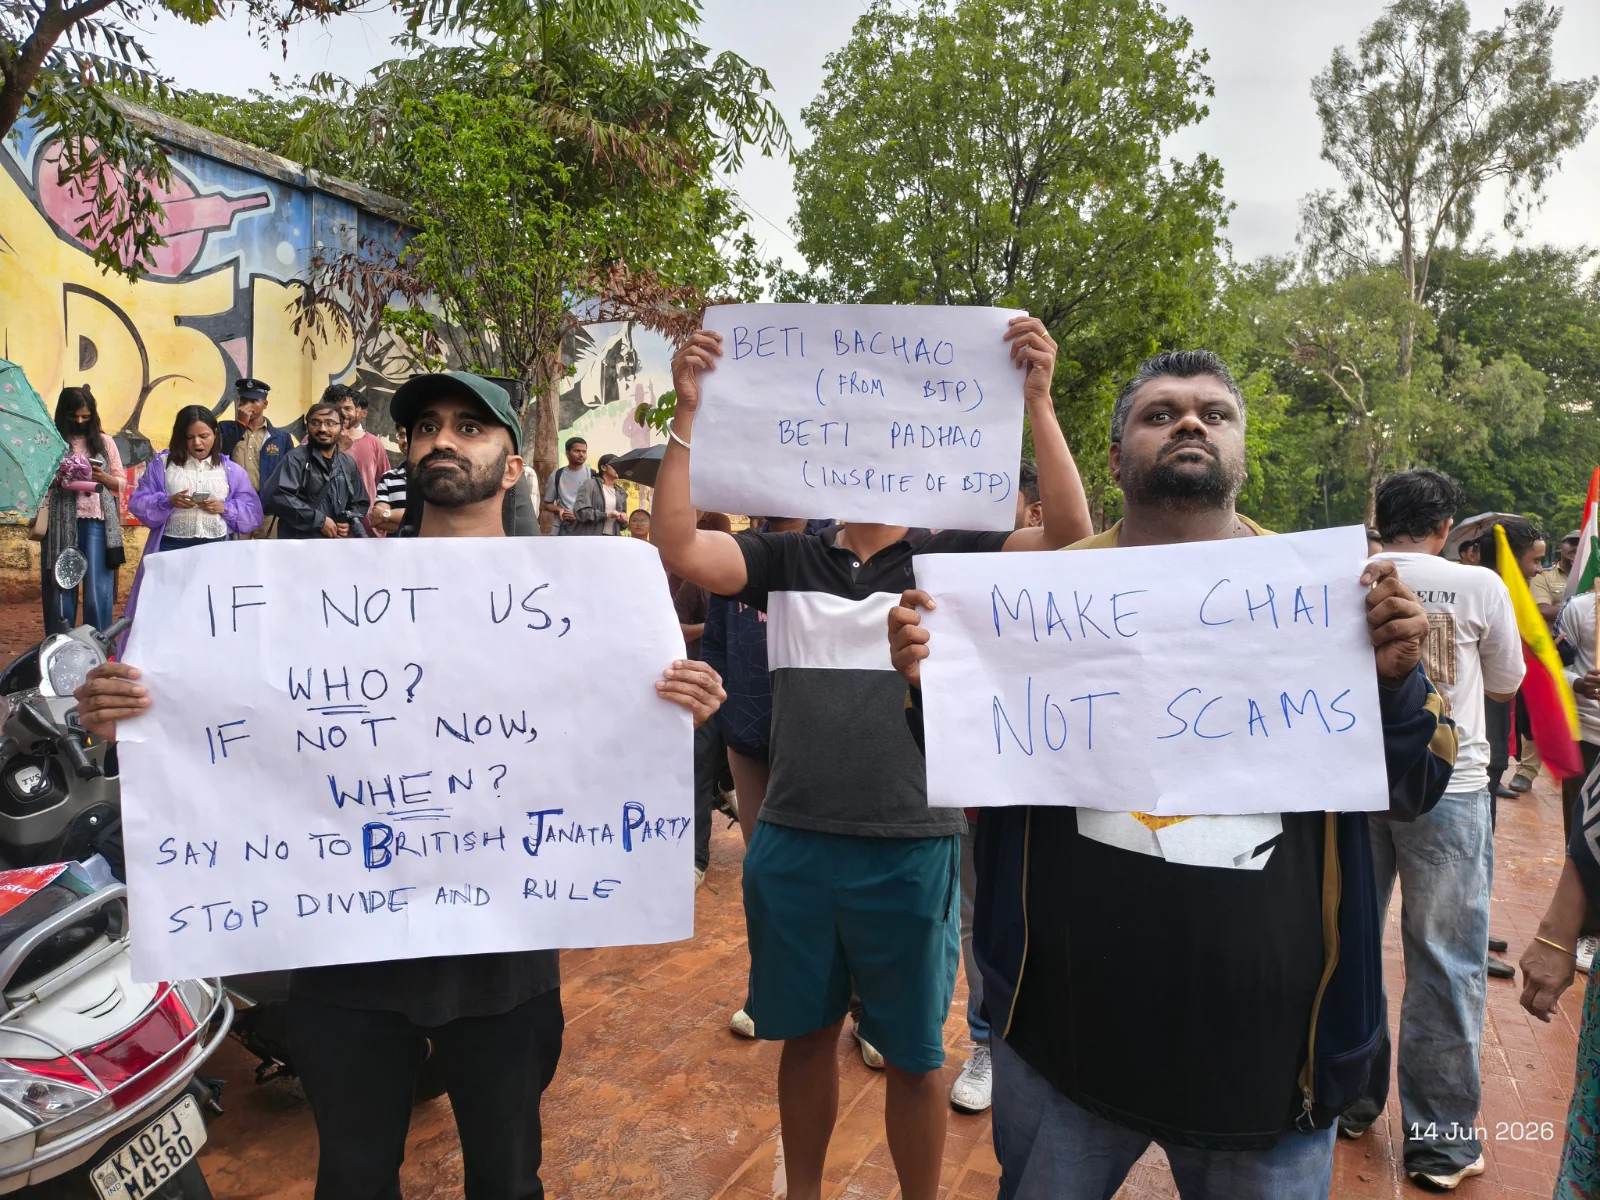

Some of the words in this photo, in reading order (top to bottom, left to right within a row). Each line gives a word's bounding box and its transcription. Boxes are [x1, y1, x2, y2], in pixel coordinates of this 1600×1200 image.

[732, 326, 804, 360] BETI
[835, 330, 953, 365] BACHAO
[923, 379, 984, 412] BJP)
[779, 420, 848, 446] BETI
[891, 421, 981, 449] PADHAO
[802, 461, 914, 493] (INSPITE
[926, 473, 948, 492] OF
[962, 471, 1011, 502] BJP)
[207, 585, 266, 637] IF
[322, 585, 438, 628] NOT
[490, 583, 571, 637] US,
[991, 584, 1148, 642] MAKE
[1199, 579, 1329, 629] CHAI
[1412, 590, 1457, 604] EUM
[288, 662, 424, 703] WHO?
[206, 720, 250, 764] IF
[297, 716, 397, 752] NOT
[436, 710, 538, 745] NOW,
[993, 677, 1120, 756] NOT
[1157, 688, 1356, 739] SCAMS
[22, 773, 41, 785] TVS
[327, 764, 507, 809] WHEN?
[157, 837, 218, 869] SAY
[245, 835, 289, 861] NO
[309, 832, 352, 860] TO
[0, 882, 38, 894] ister
[168, 900, 269, 933] STOP
[297, 887, 416, 918] DIVIDE
[435, 883, 490, 906] AND
[523, 878, 622, 901] RULE
[112, 1111, 182, 1180] KA02J
[124, 1135, 193, 1200] M4580
[107, 1182, 122, 1197] IND
